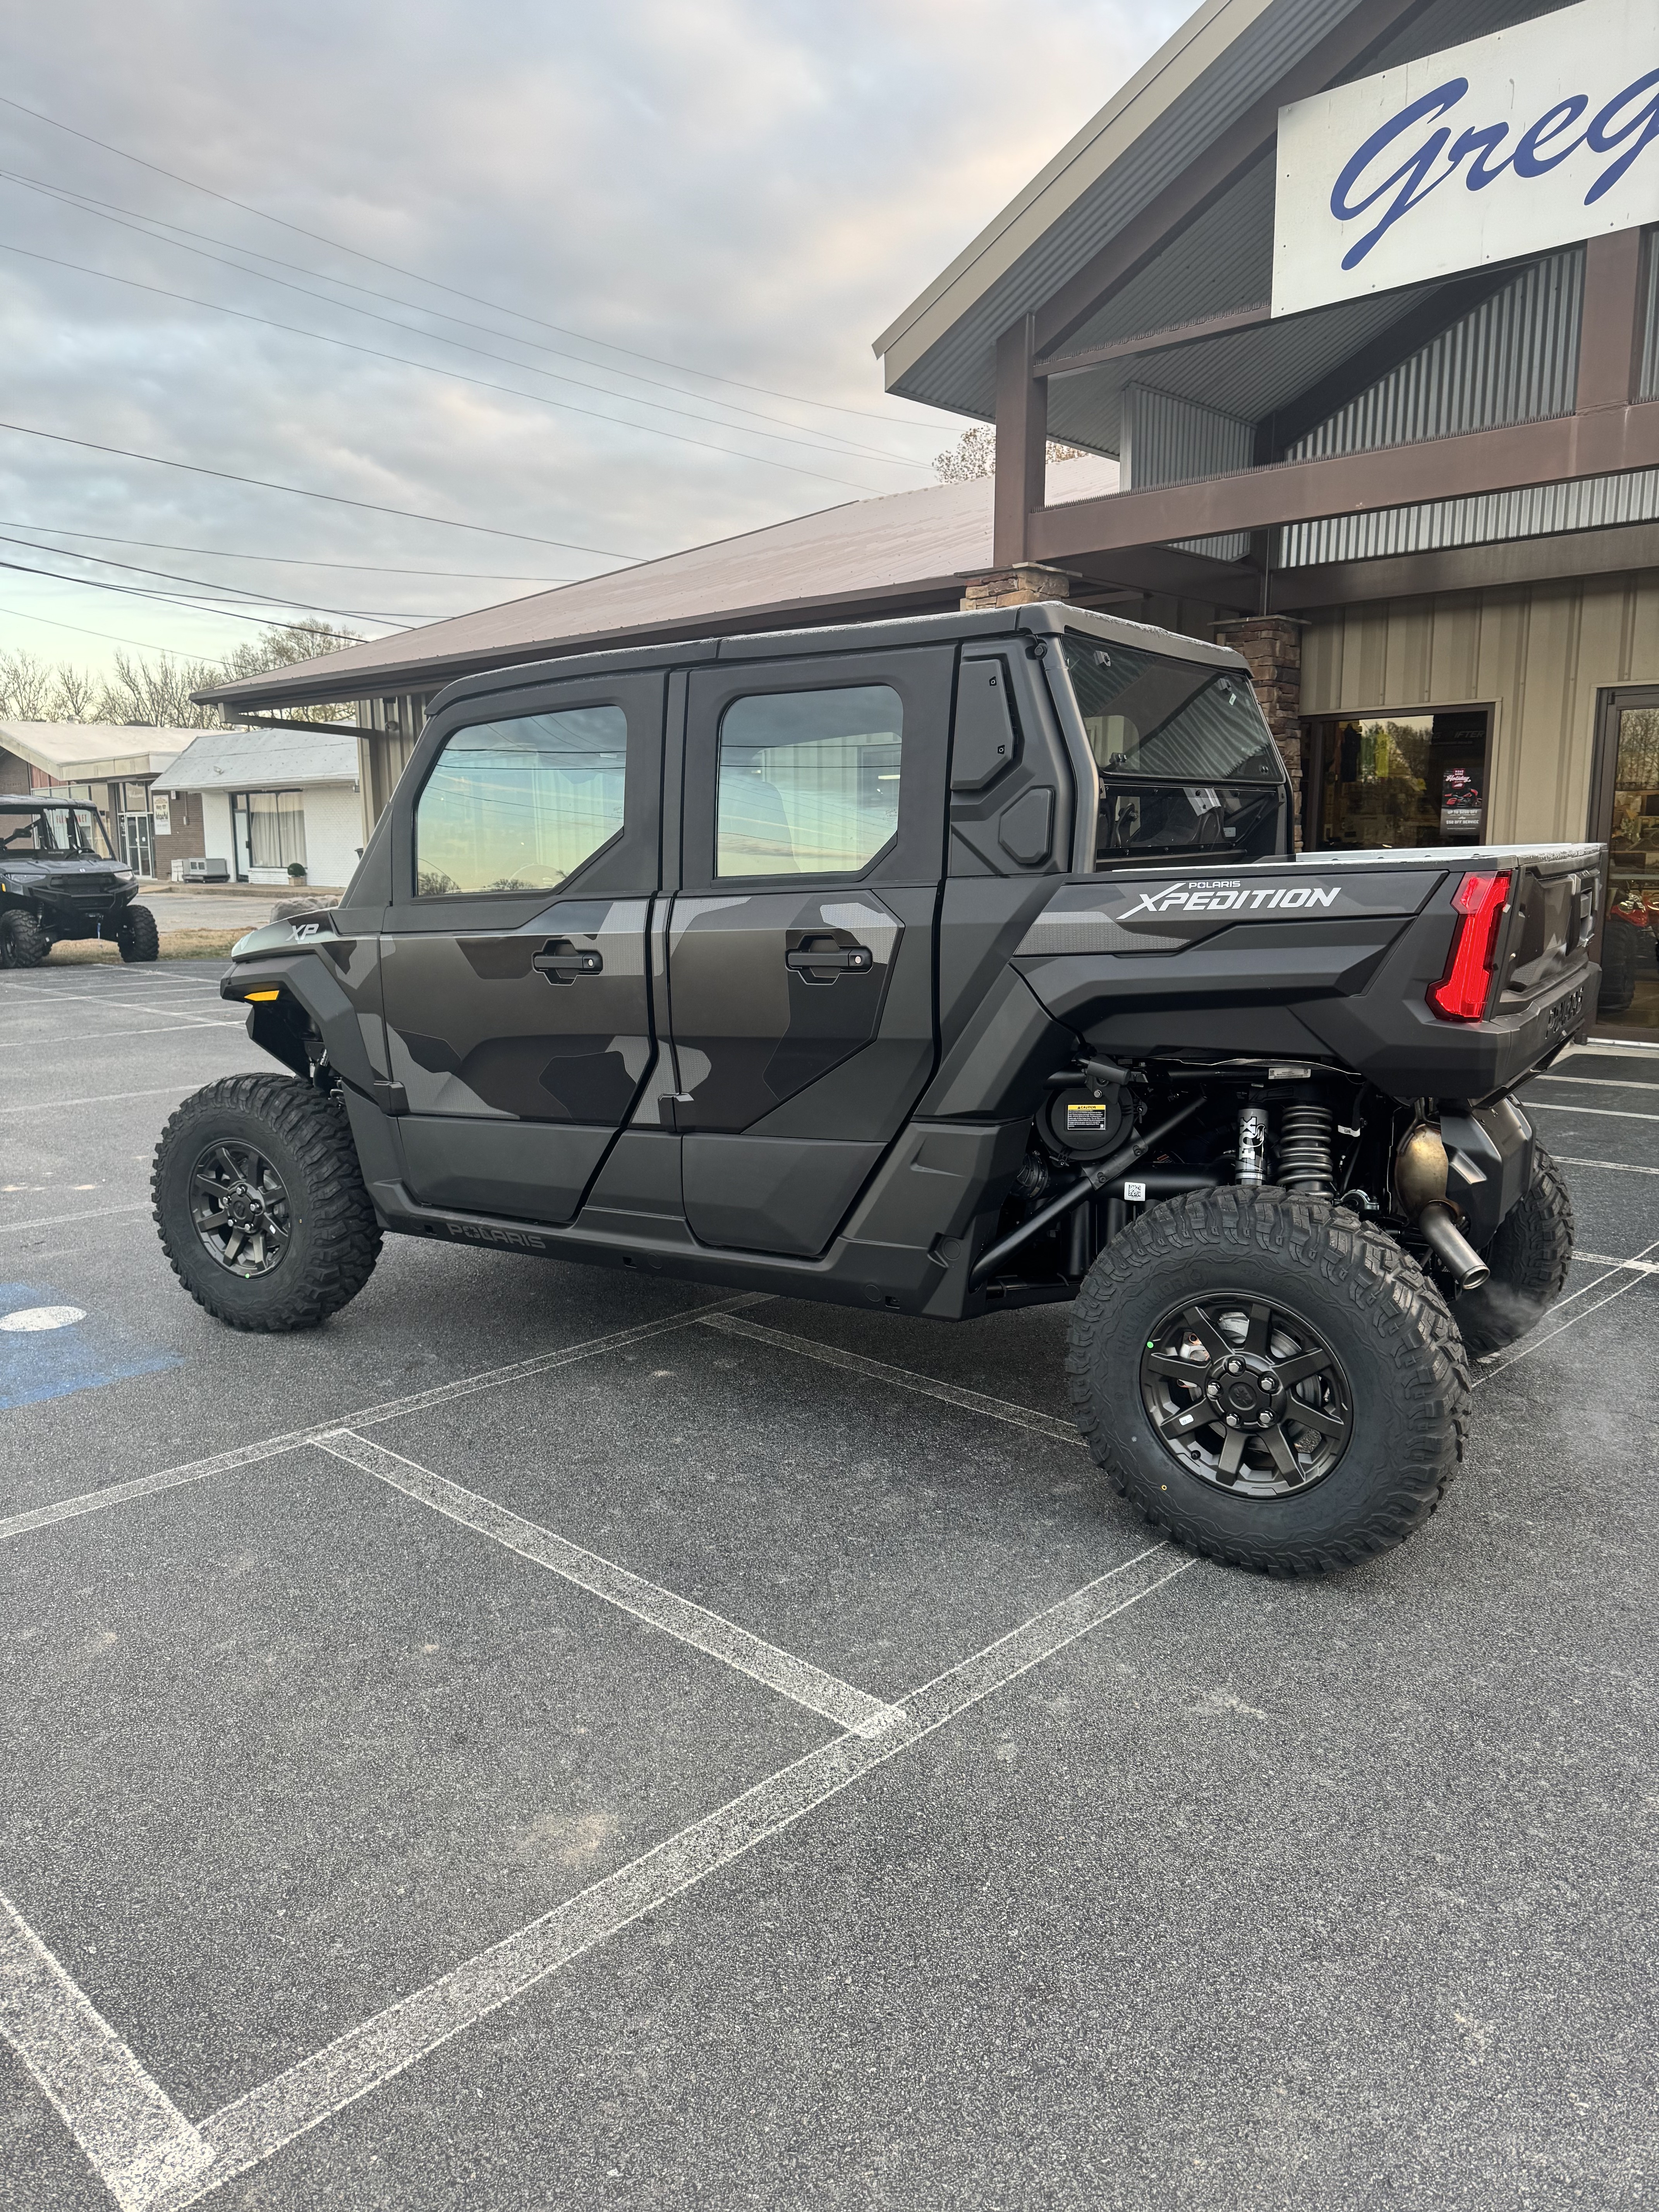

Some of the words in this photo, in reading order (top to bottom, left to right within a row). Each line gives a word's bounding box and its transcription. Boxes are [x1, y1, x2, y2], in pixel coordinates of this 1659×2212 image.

[1188, 881, 1241, 889] POLARIS
[1116, 883, 1341, 920] XPEDITION
[285, 923, 319, 941] XP
[1239, 1117, 1266, 1160] FOX
[446, 1223, 546, 1249] POLARIS
